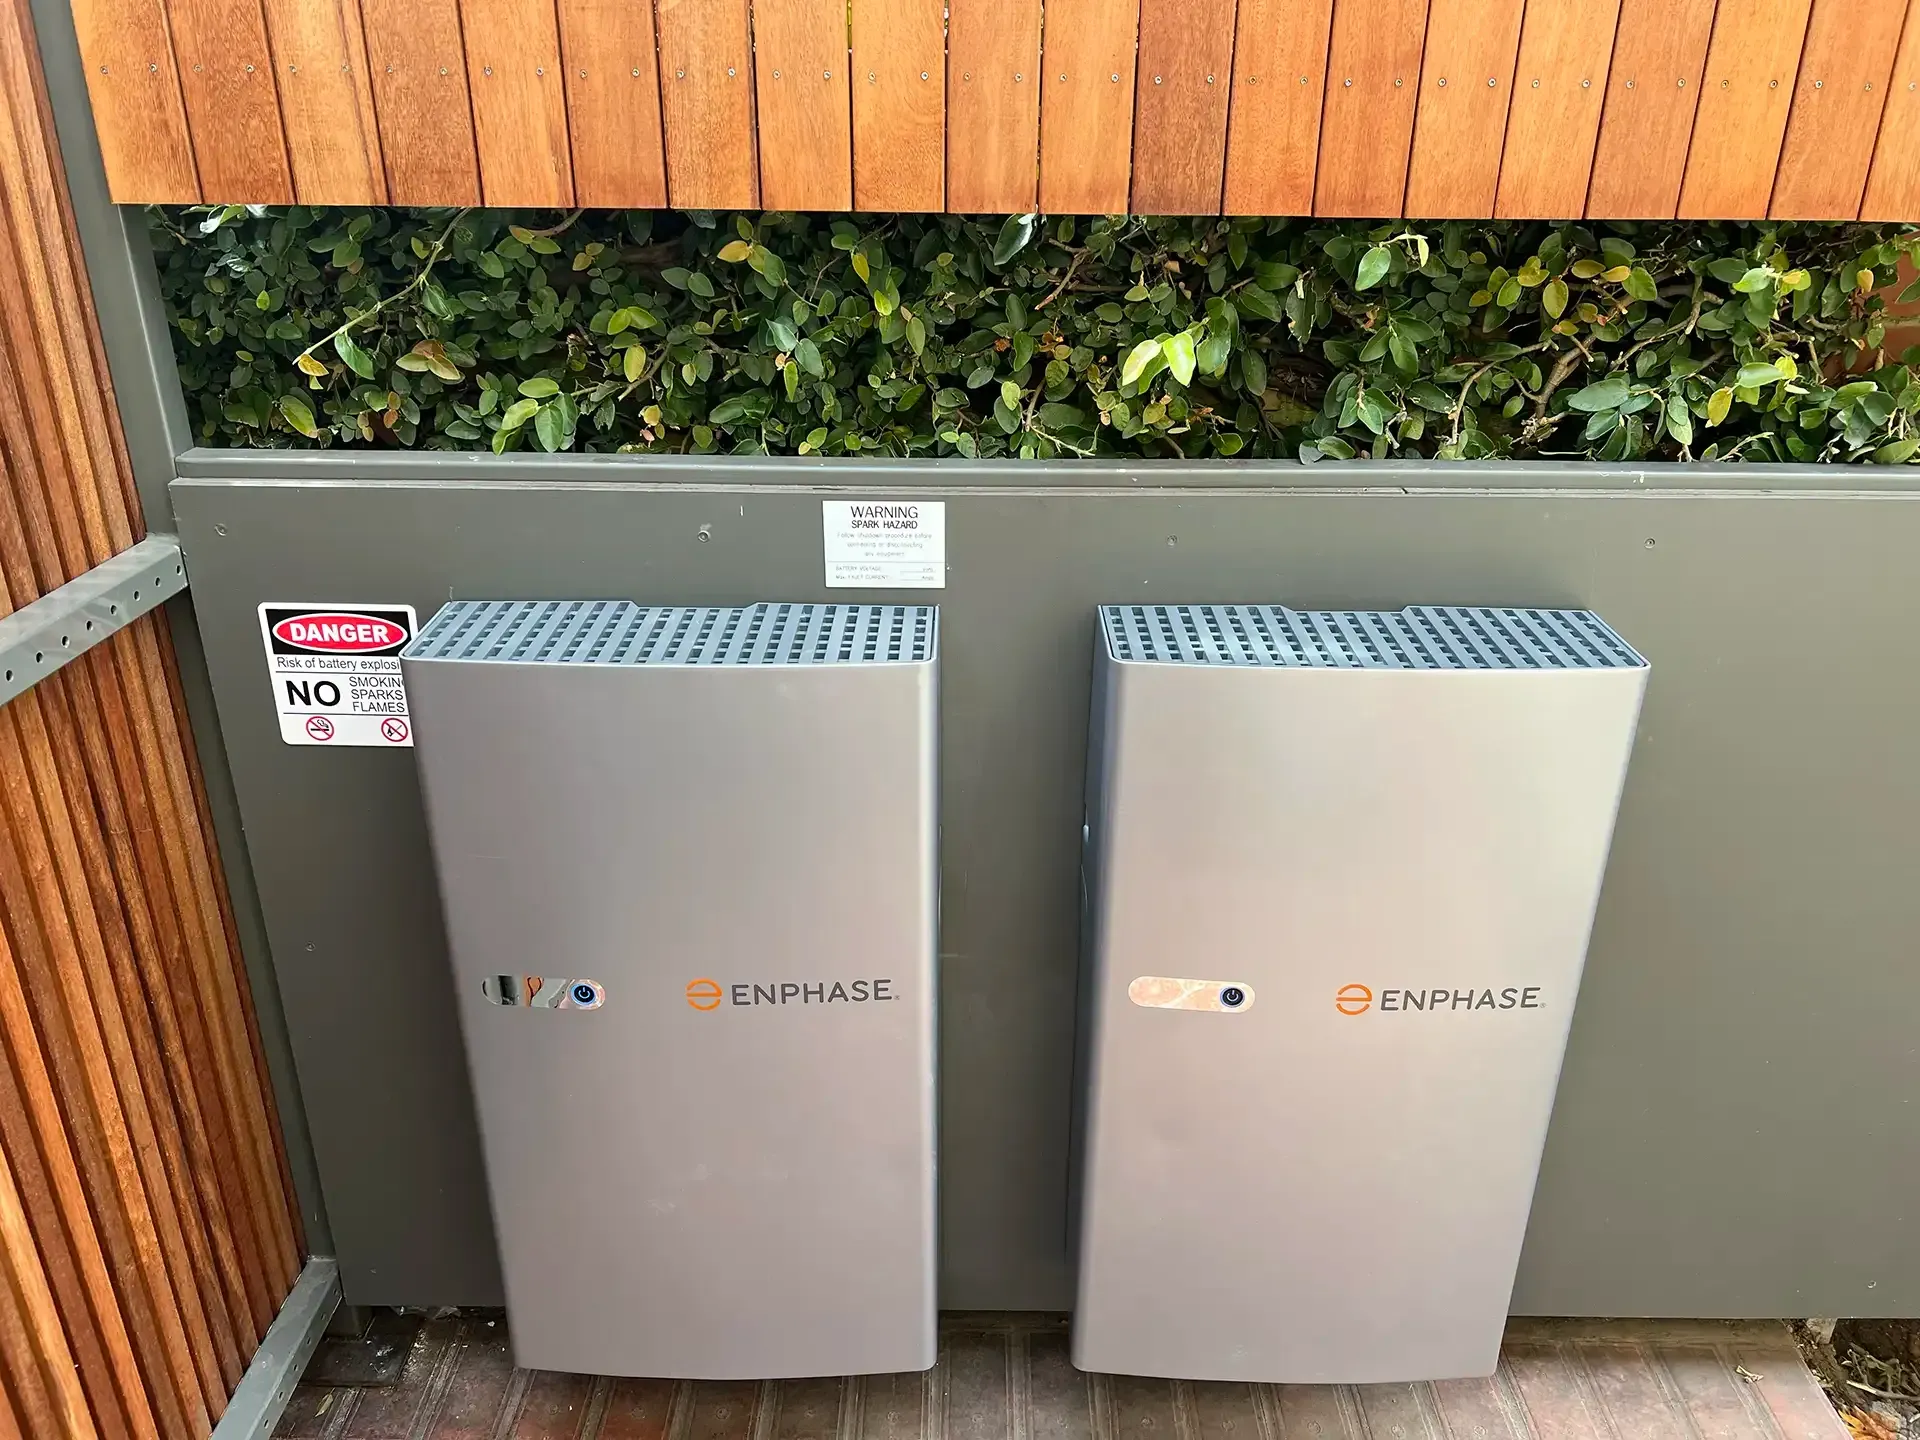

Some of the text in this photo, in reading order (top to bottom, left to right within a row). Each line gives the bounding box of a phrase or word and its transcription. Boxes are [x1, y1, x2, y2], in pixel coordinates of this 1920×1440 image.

[851, 506, 919, 519] WARNING
[851, 520, 918, 529] SPARK HAZARD
[289, 623, 391, 643] DANGER
[276, 656, 401, 672] Risk of battery explosi
[286, 680, 341, 707] NO
[351, 689, 404, 701] SPARKS
[352, 701, 406, 713] FLAMES
[731, 979, 893, 1006] ENPHASE
[1380, 987, 1541, 1011] ENPHASE
